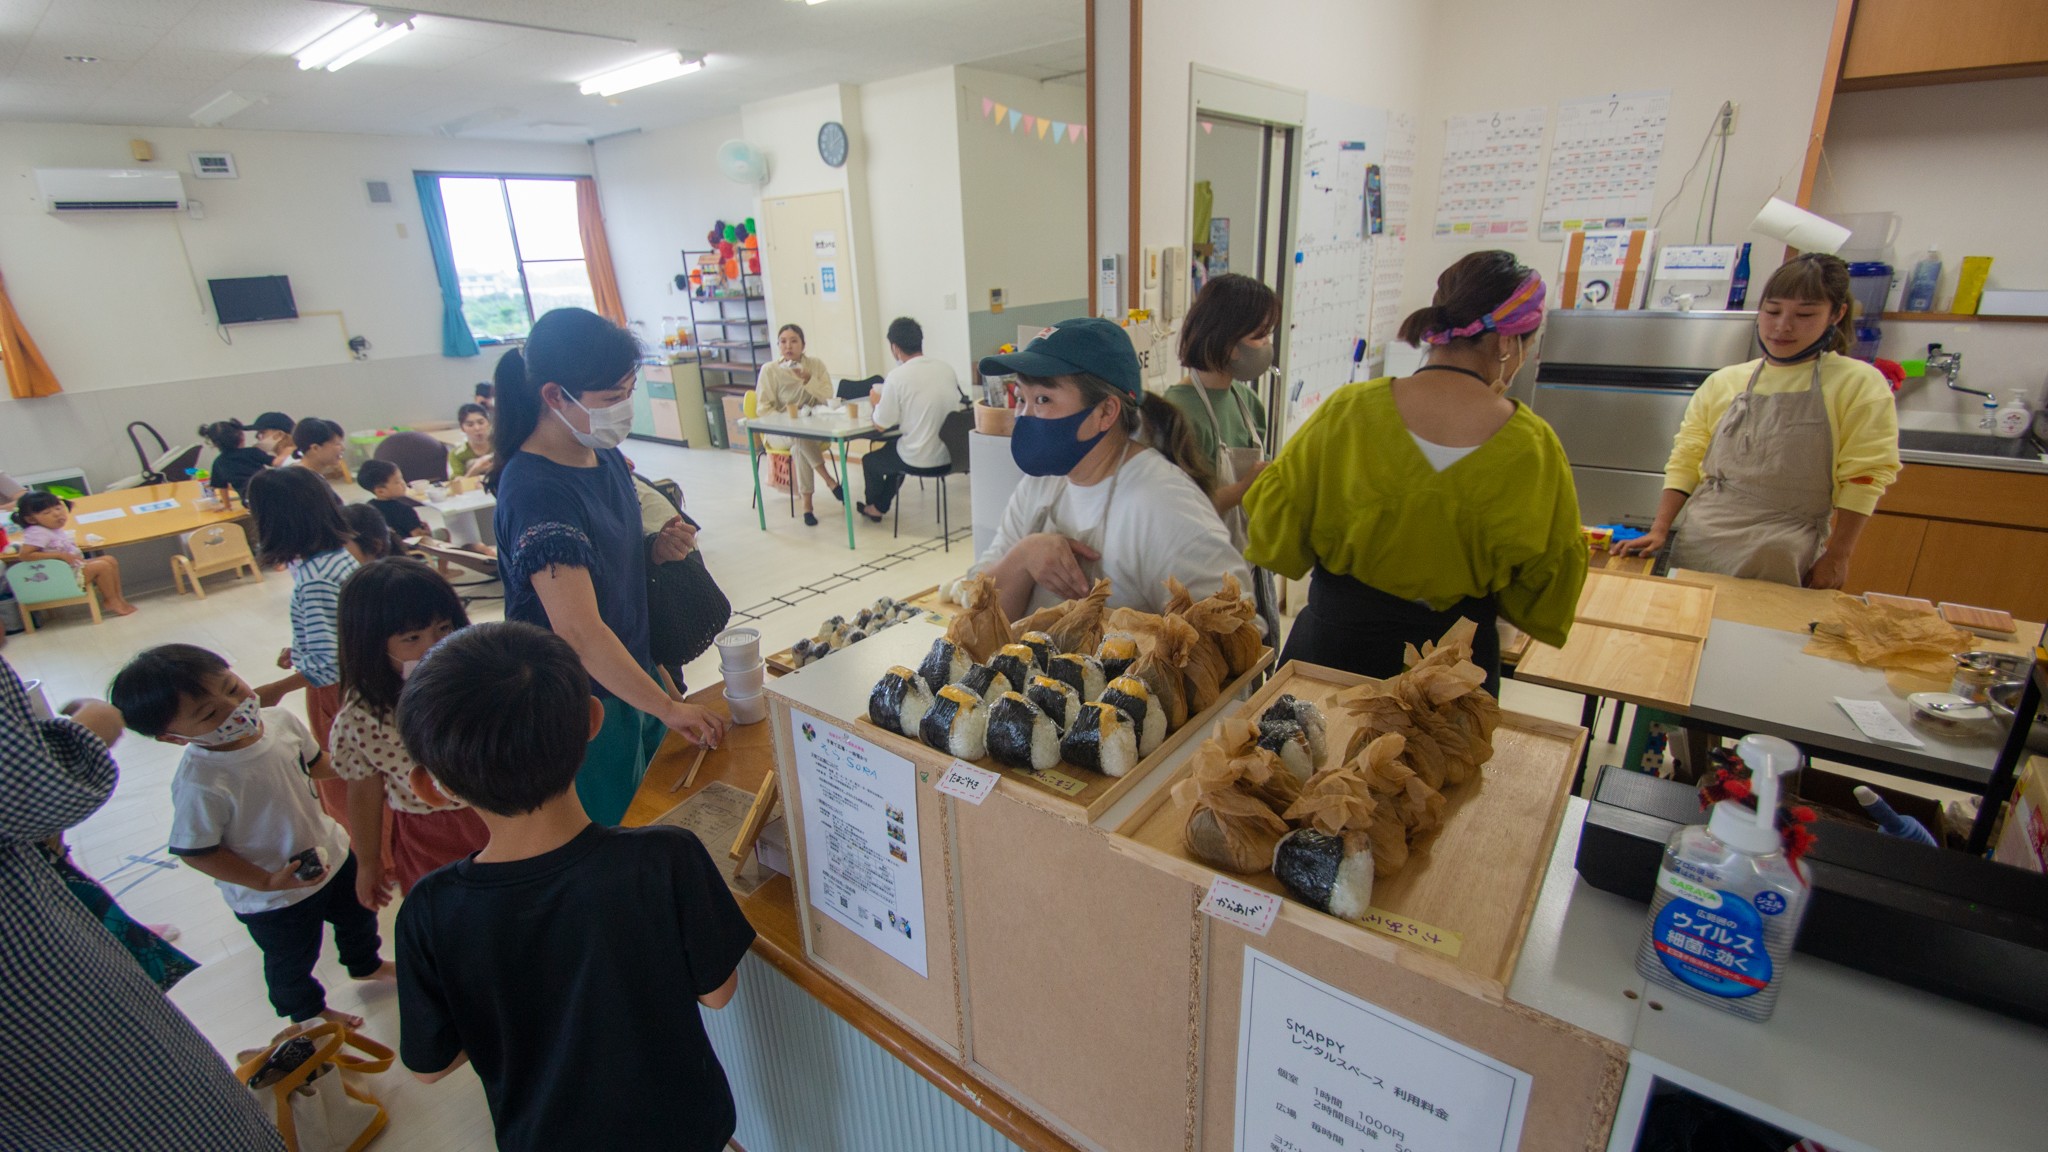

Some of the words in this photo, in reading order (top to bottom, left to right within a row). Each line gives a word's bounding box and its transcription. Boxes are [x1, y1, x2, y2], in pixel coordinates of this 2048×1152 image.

[1490, 112, 1501, 128] 6
[1608, 101, 1619, 119] 7
[949, 772, 979, 790] たまごやき
[1669, 876, 1718, 901] SARAYA
[1215, 897, 1263, 917] からあげ
[1361, 914, 1442, 945] からあげ
[1673, 911, 1755, 954] ウイルス
[1665, 929, 1749, 971] 細菌に効く
[1286, 1018, 1345, 1054] SMAPPY
[1291, 1034, 1385, 1090] レンタルスペース
[1393, 1086, 1449, 1122] 利用料金
[1277, 1067, 1299, 1086] 個室
[1313, 1087, 1343, 1110] 1時間
[1357, 1110, 1405, 1142] 1000円
[1275, 1102, 1297, 1120] 広場
[1311, 1121, 1344, 1147] 毎時間
